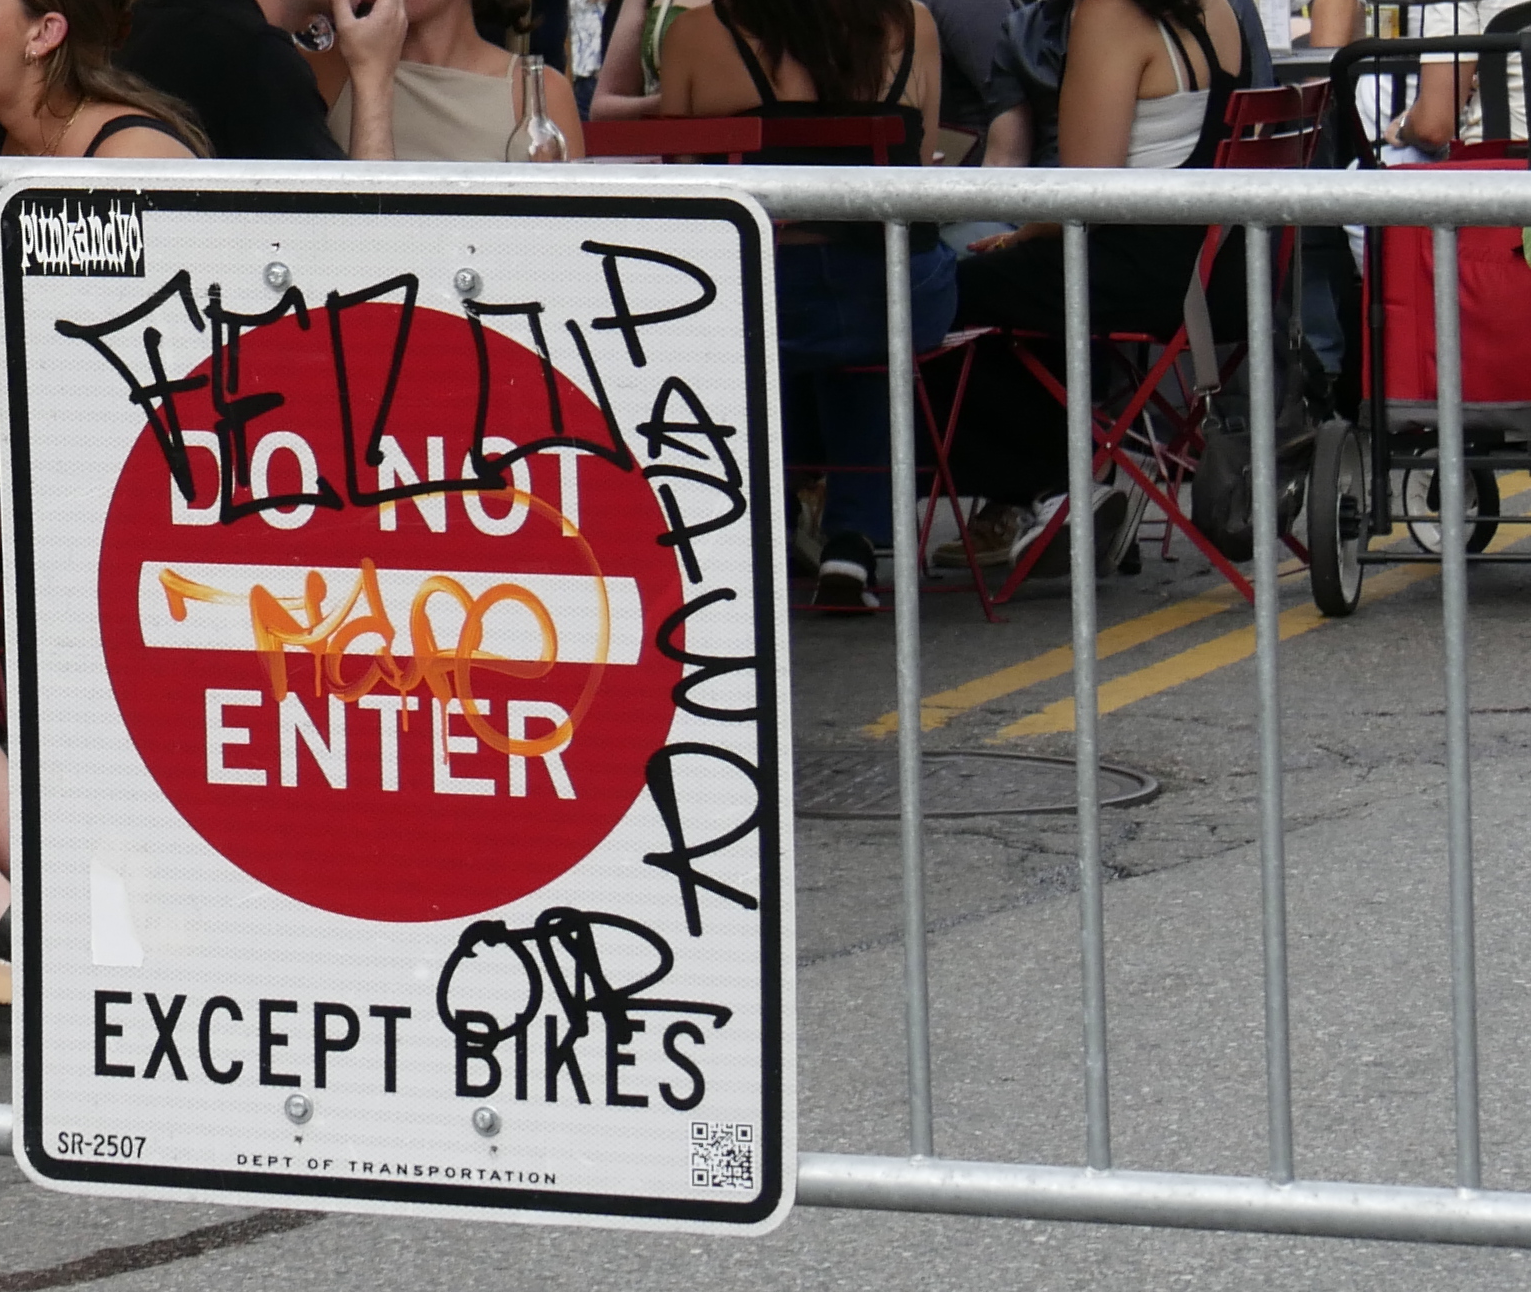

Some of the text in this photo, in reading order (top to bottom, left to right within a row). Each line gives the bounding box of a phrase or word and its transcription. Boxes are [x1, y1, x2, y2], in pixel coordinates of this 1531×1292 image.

[169, 428, 582, 538] DO NOT
[204, 688, 577, 801] ENTER
[93, 989, 707, 1112] EXCEPT BIKES
[56, 1131, 148, 1160] SR-2507
[236, 1153, 558, 1186] DEPT OF TRANSPORTATION
